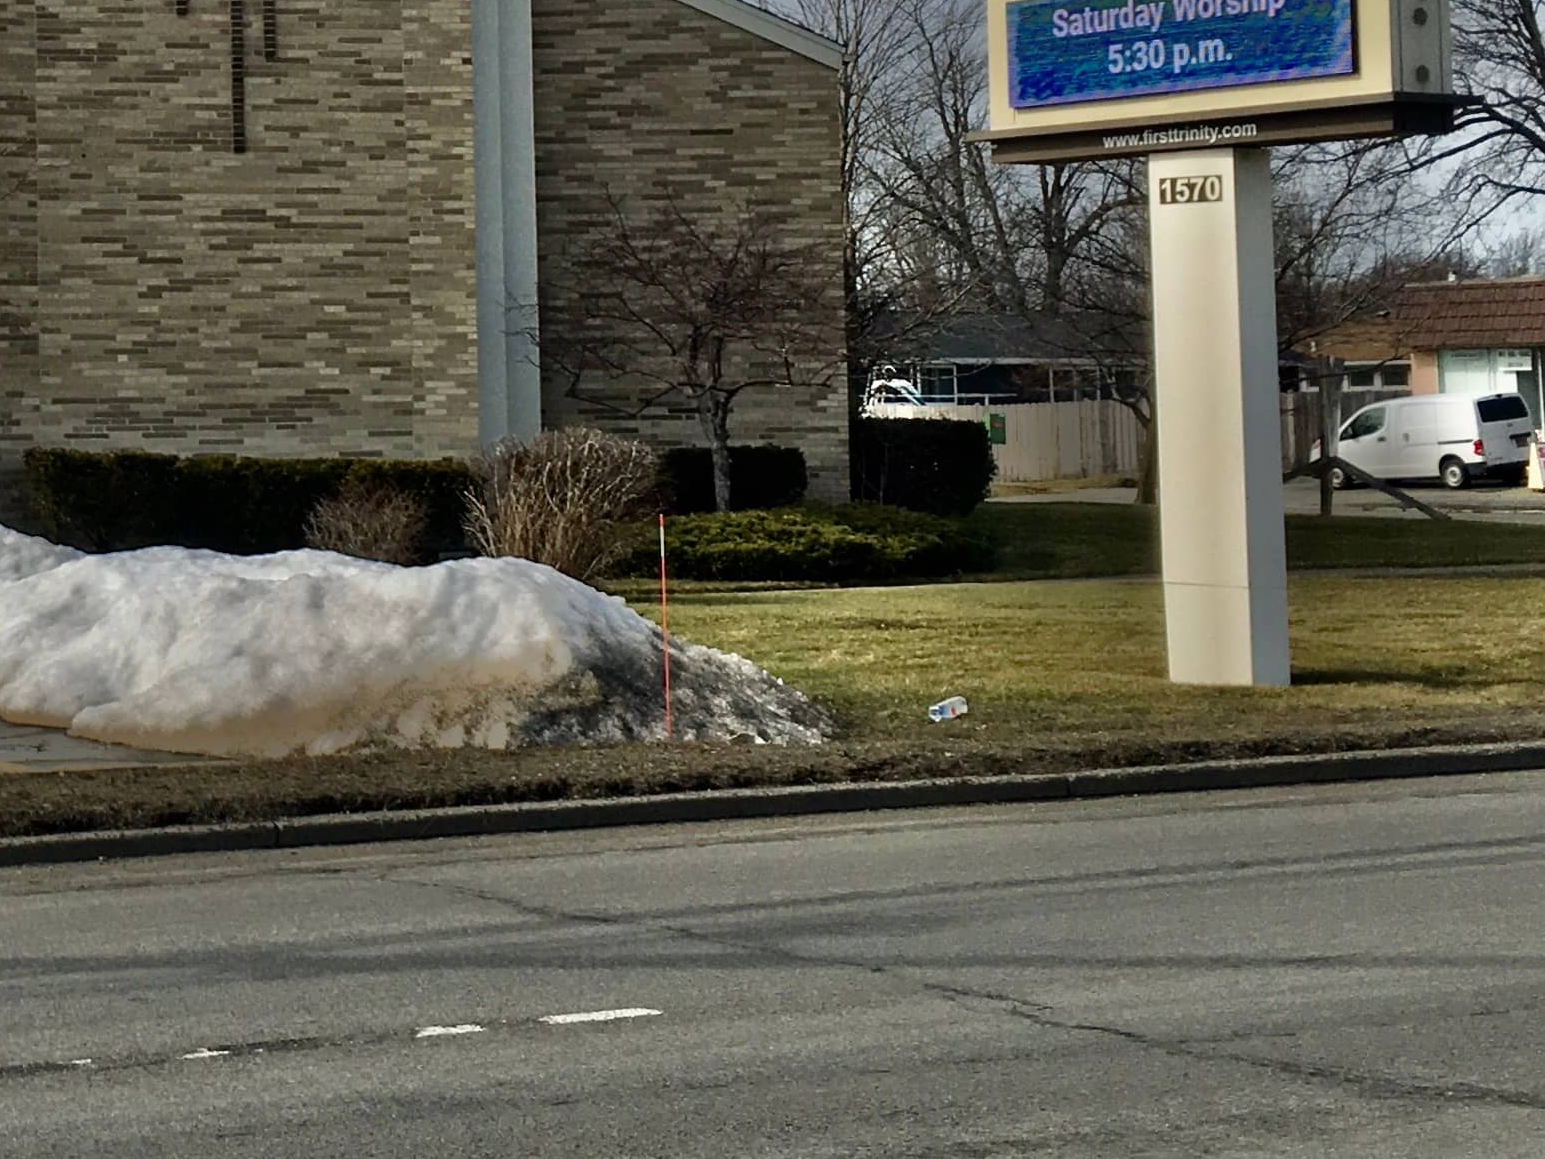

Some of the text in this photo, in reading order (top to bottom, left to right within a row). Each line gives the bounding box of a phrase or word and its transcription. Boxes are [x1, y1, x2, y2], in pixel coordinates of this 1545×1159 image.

[1107, 37, 1233, 74] 5:30 p.m.
[1102, 123, 1257, 149] www.firsttrinity.com
[1160, 176, 1221, 203] 1570
